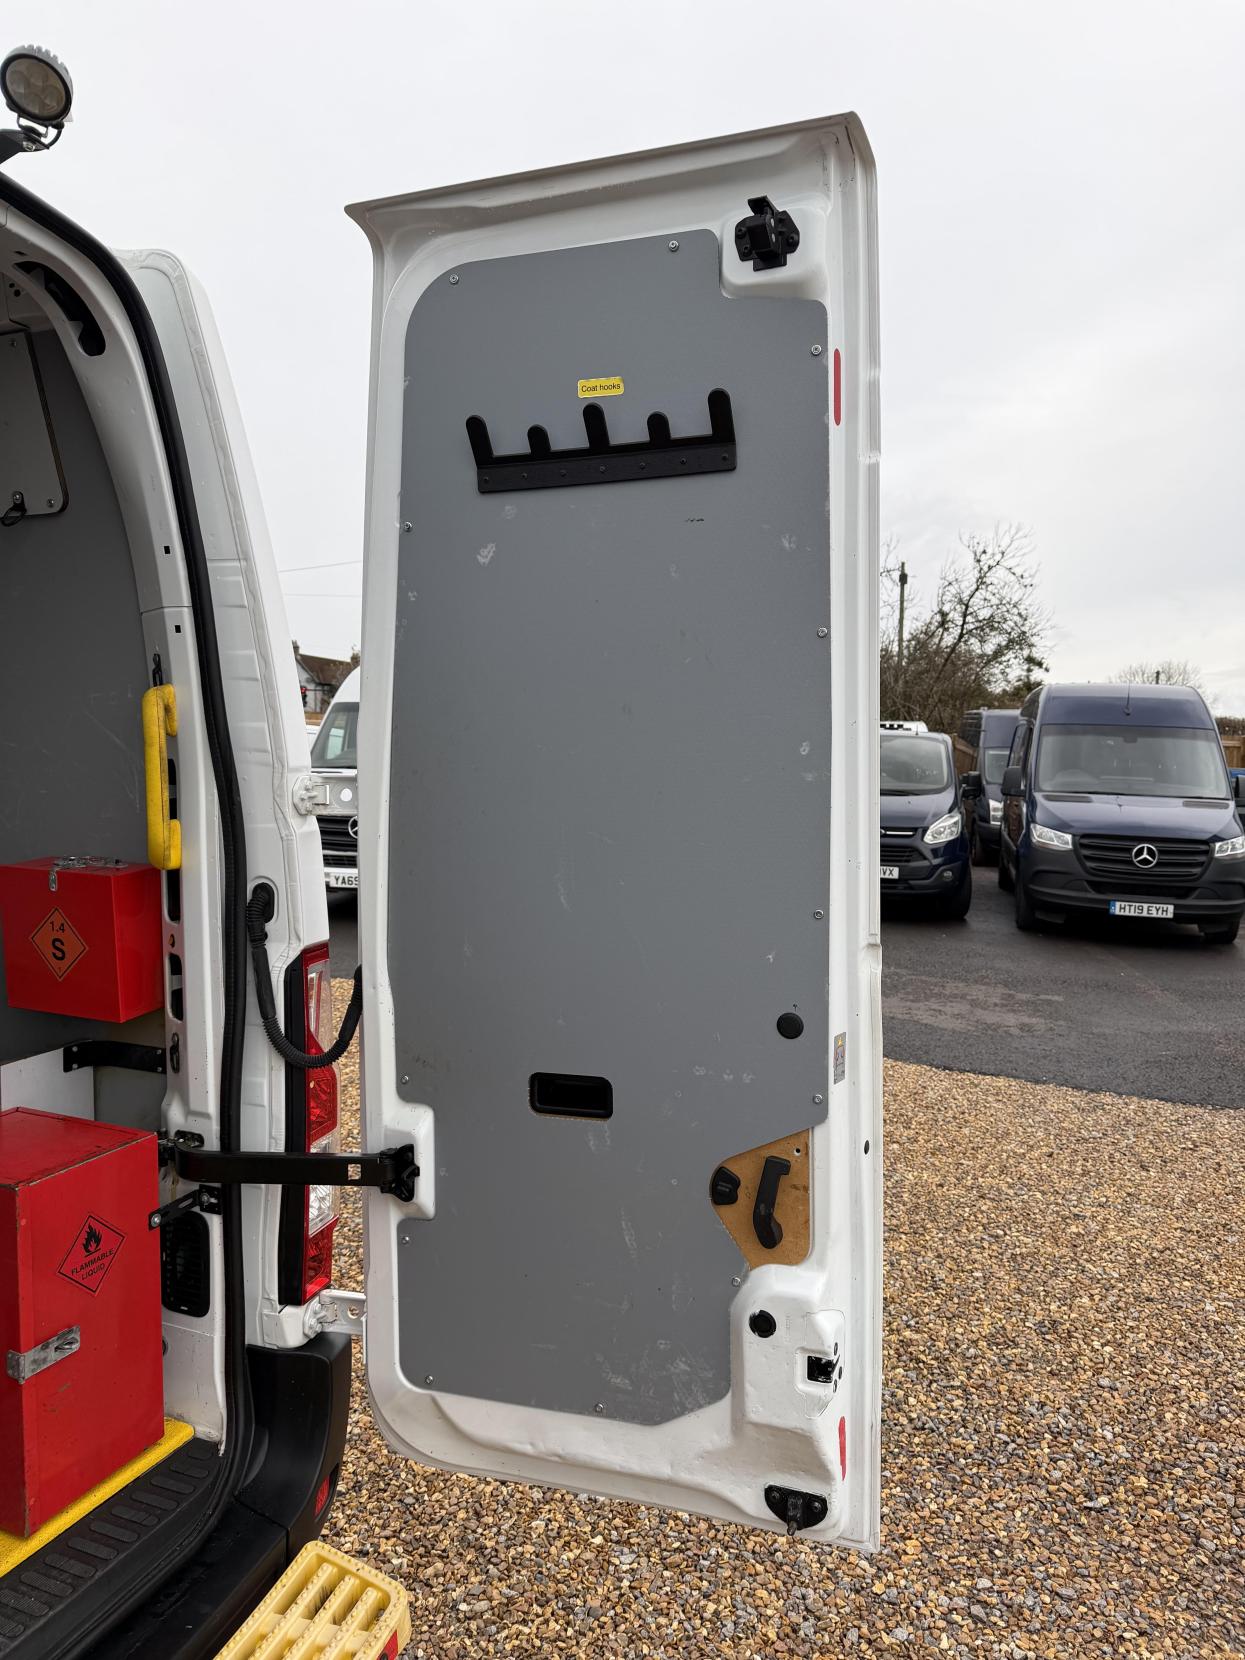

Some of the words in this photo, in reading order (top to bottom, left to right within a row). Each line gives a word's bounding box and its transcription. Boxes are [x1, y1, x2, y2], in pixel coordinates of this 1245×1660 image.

[581, 384, 598, 393] Coat
[599, 382, 621, 391] hooks
[880, 867, 895, 877] VX
[1118, 904, 1144, 914] HT19
[1146, 905, 1169, 916] EYH
[49, 921, 65, 933] 1.4
[51, 938, 66, 961] S
[71, 1249, 114, 1276] FLAMMABLE
[81, 1262, 106, 1280] LIQUID
